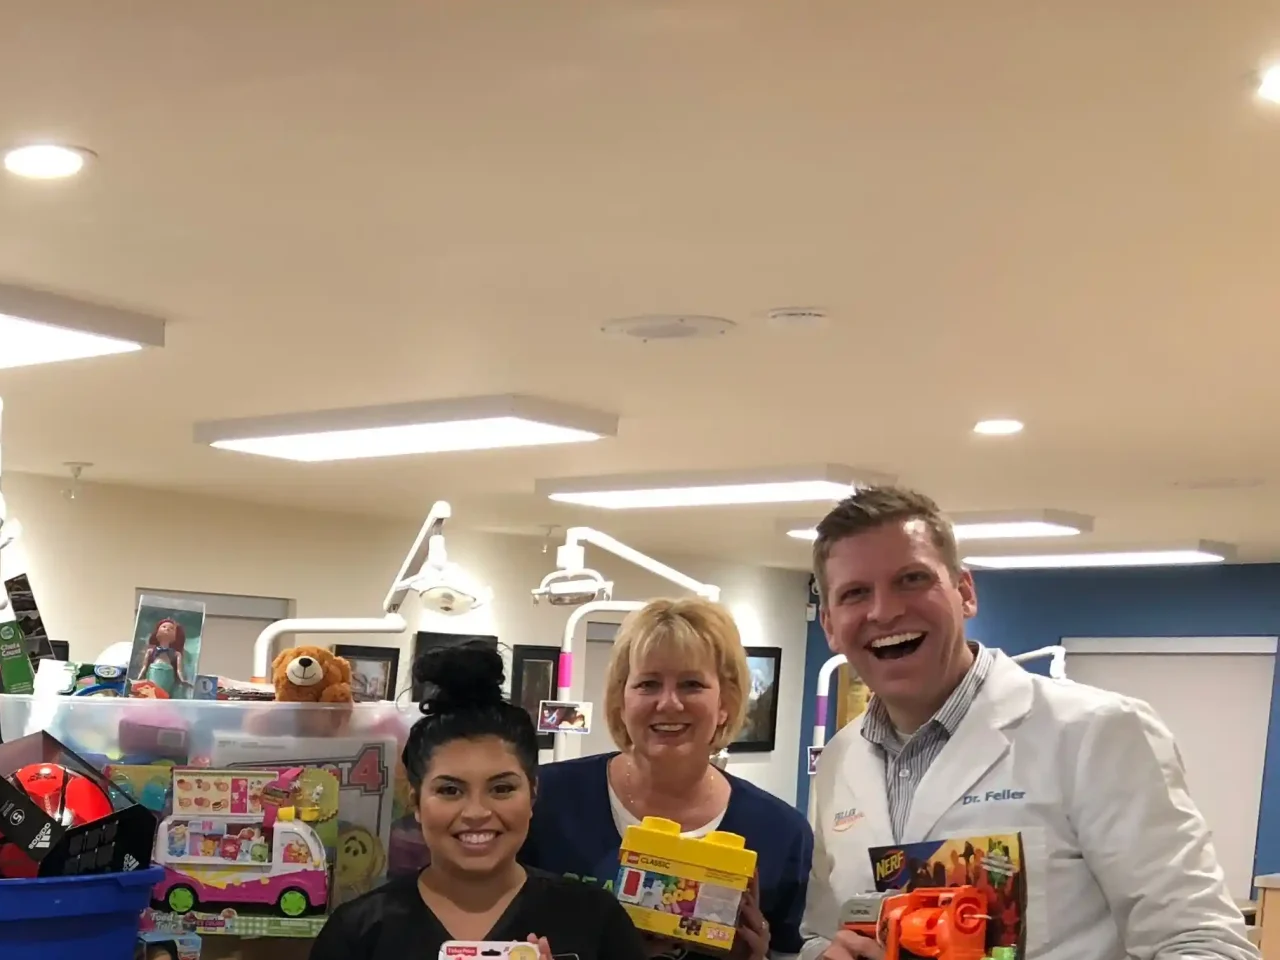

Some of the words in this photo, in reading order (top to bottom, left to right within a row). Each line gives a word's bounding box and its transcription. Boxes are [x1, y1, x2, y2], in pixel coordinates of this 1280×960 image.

[350, 746, 387, 790] 4
[963, 795, 982, 806] Dr.
[985, 789, 1027, 802] Feller
[28, 822, 52, 850] adidas
[640, 857, 671, 870] CLASSIC
[876, 851, 904, 882] NERF
